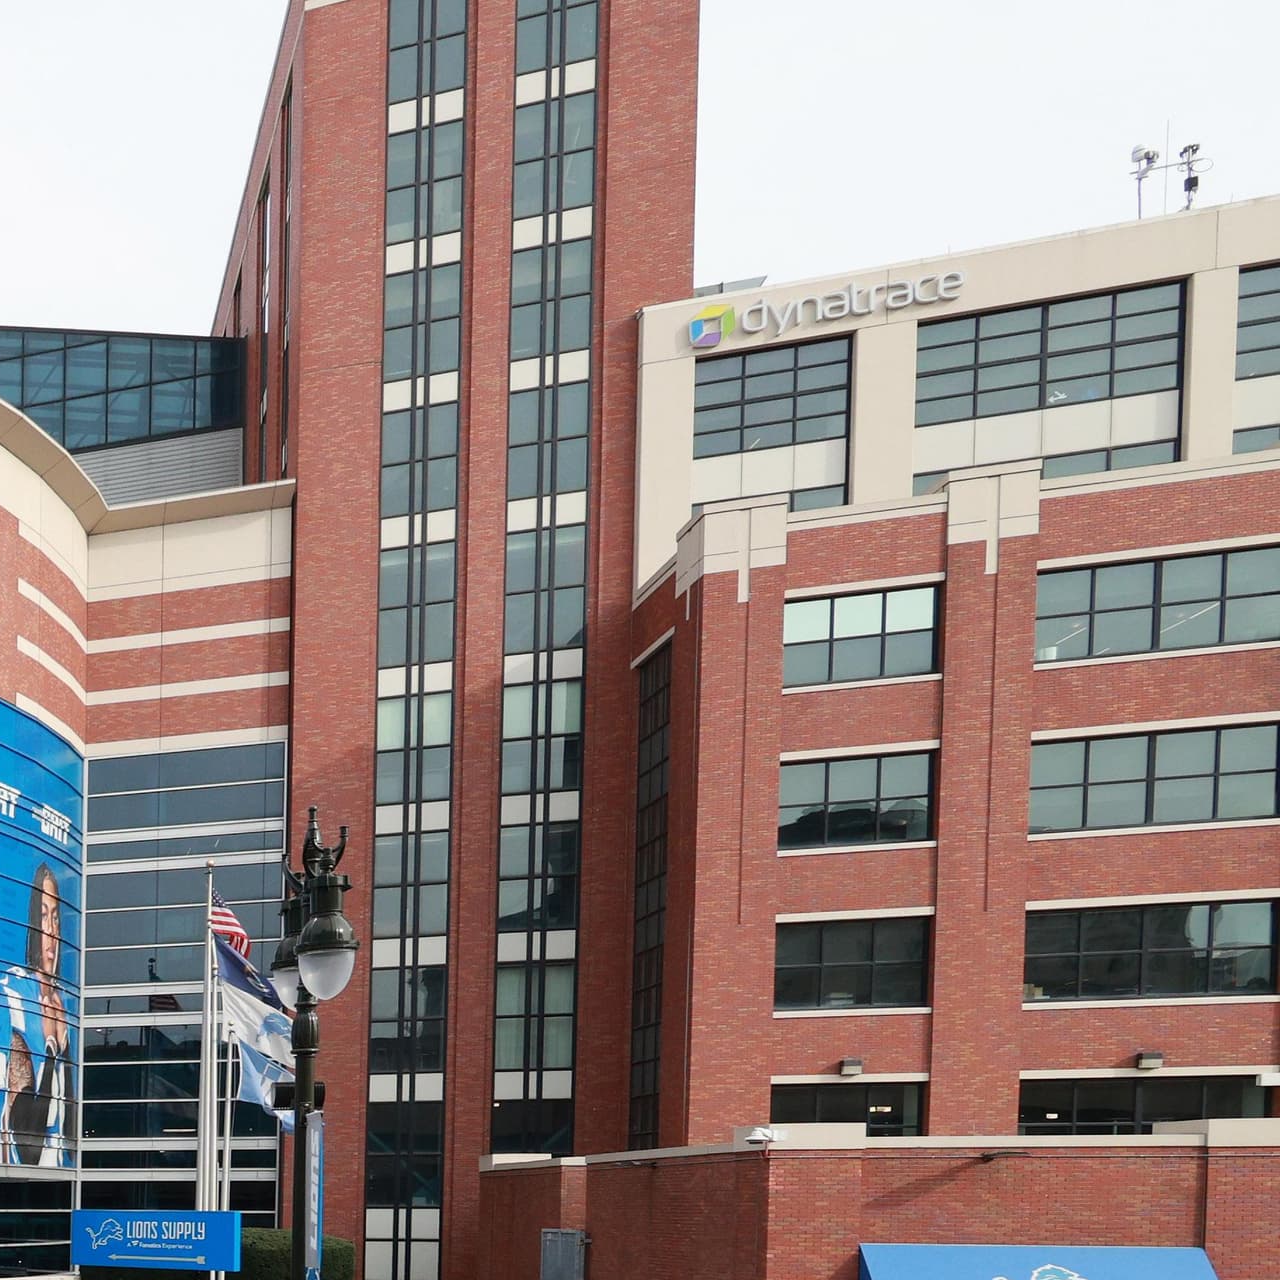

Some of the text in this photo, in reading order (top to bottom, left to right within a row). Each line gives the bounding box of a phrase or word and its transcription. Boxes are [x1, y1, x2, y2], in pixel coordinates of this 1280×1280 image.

[740, 267, 967, 338] dynatrace
[126, 1221, 206, 1240] LIONS SUPPLY
